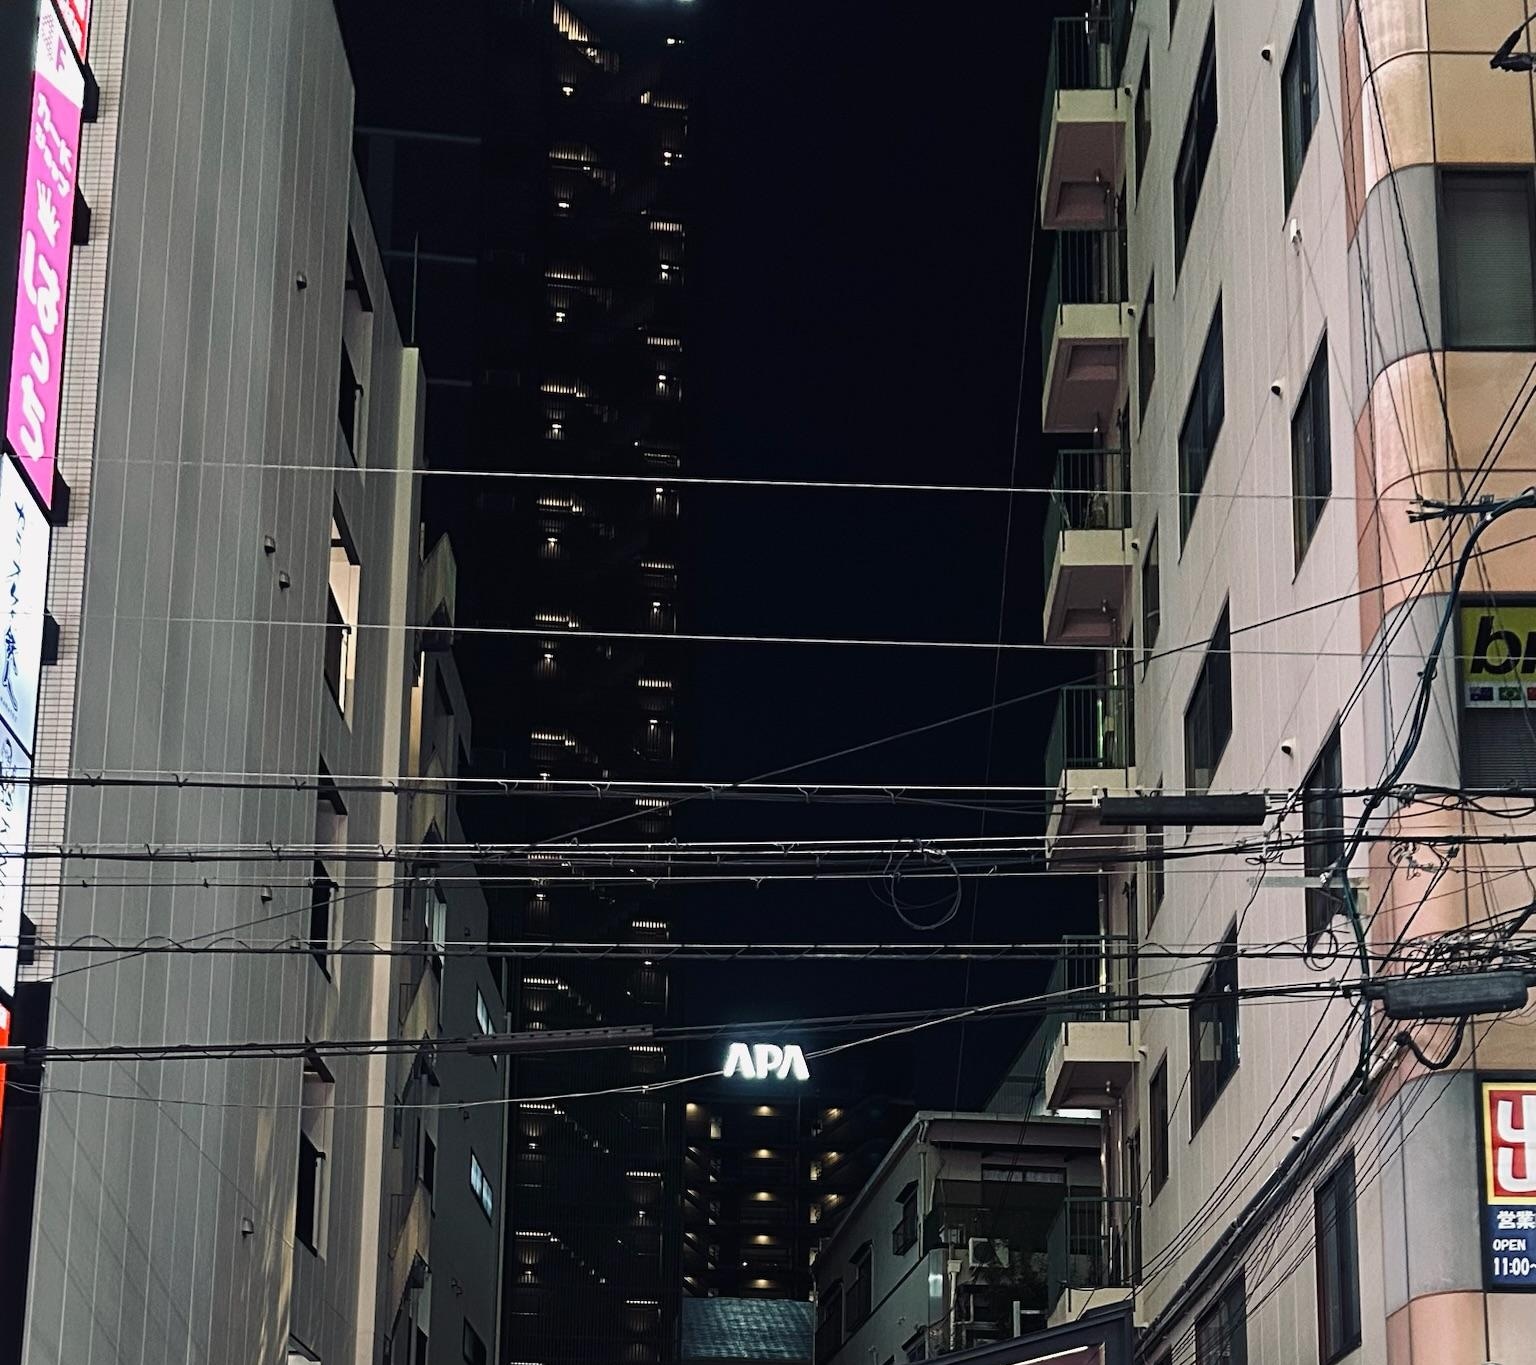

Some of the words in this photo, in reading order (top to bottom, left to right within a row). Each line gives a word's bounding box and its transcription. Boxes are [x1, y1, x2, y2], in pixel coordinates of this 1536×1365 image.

[20, 230, 61, 462] はっち
[723, 1041, 811, 1081] APA
[1492, 1238, 1527, 1252] OPEN
